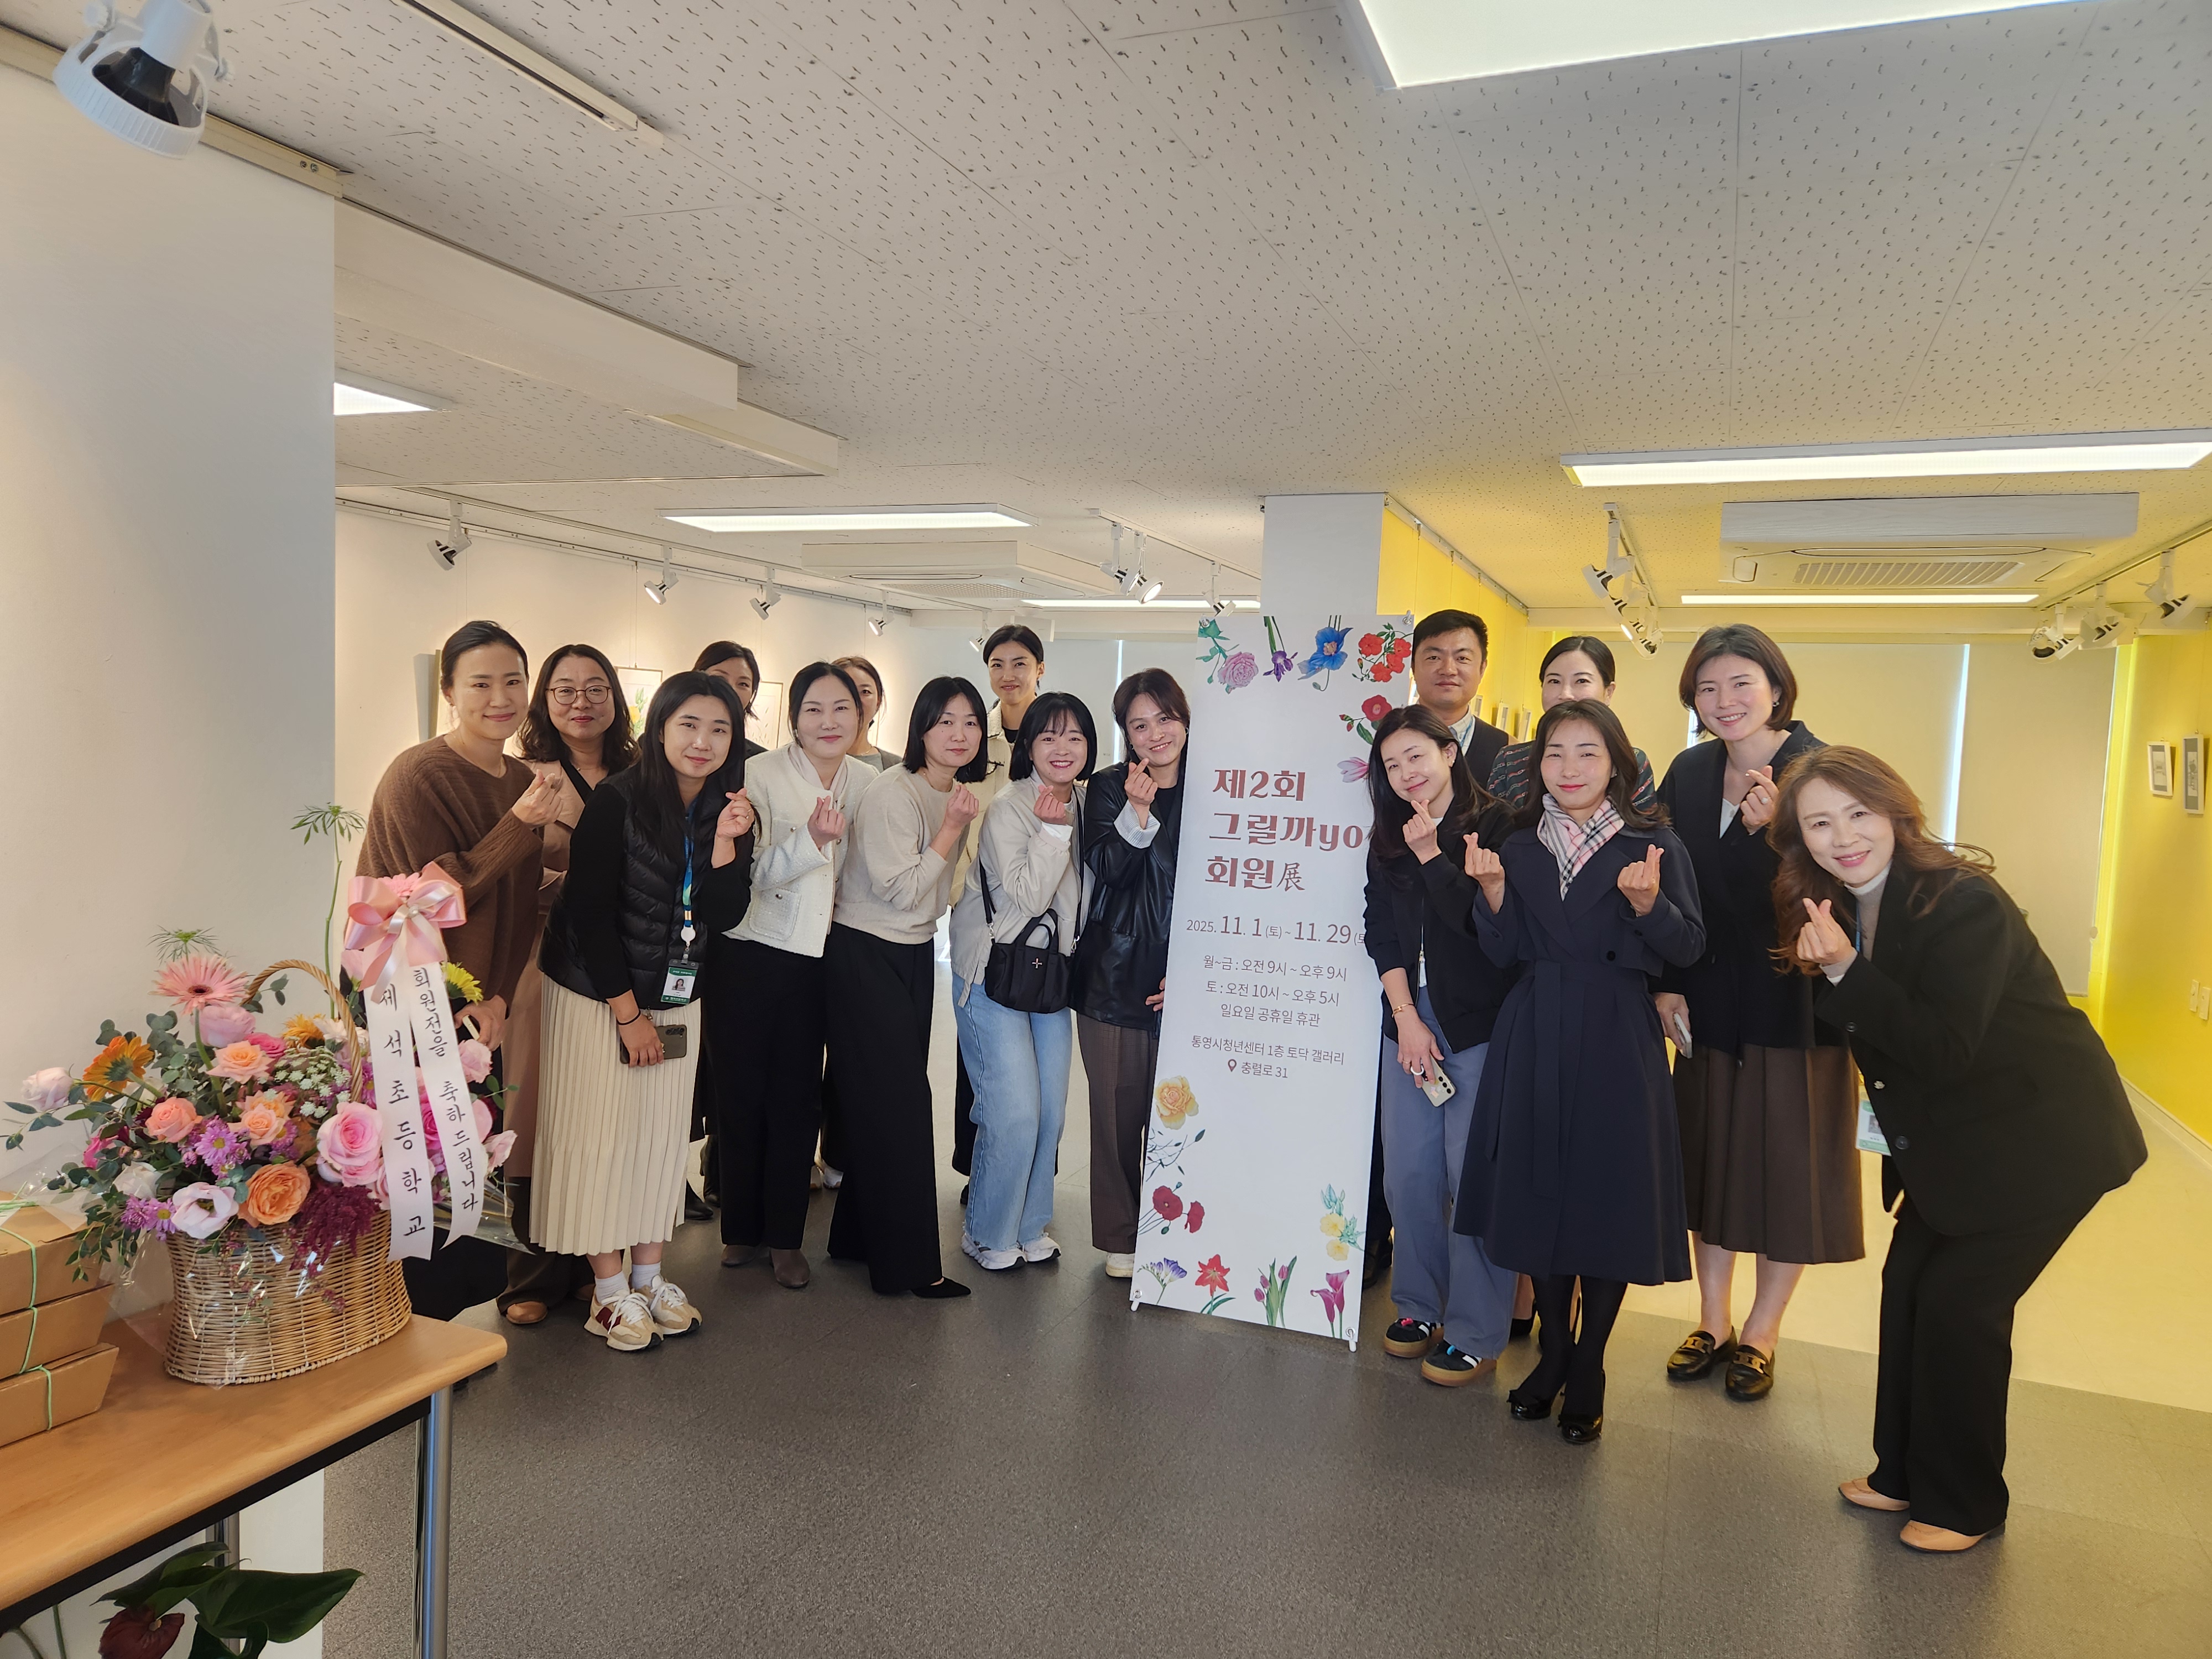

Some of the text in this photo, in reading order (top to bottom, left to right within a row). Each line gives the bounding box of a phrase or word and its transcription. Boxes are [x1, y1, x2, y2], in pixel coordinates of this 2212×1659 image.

[1212, 769, 1306, 802] 제2회
[1209, 812, 1363, 852] 그릴까yo
[1204, 855, 1306, 892] 회원展
[1186, 920, 1217, 932] 2025.
[1326, 924, 1351, 944] 29
[1203, 955, 1233, 970] 월~금
[1241, 959, 1265, 974] 오전
[1267, 961, 1287, 975] 9시
[1300, 964, 1324, 979] 오후
[1327, 966, 1347, 982] 9시
[1206, 981, 1217, 993] 토
[1226, 983, 1249, 997] 오전
[1252, 984, 1279, 1001] 10시
[1292, 989, 1316, 1004] 오후
[1319, 991, 1339, 1006] 5시
[414, 967, 448, 1057] 회원전을
[1220, 1004, 1320, 1027] 일요일 공휴일 휴관
[1191, 1035, 1344, 1065] 통영시청년센터 1층 토닥 갤러리
[1241, 1062, 1288, 1078] 충렬로 31
